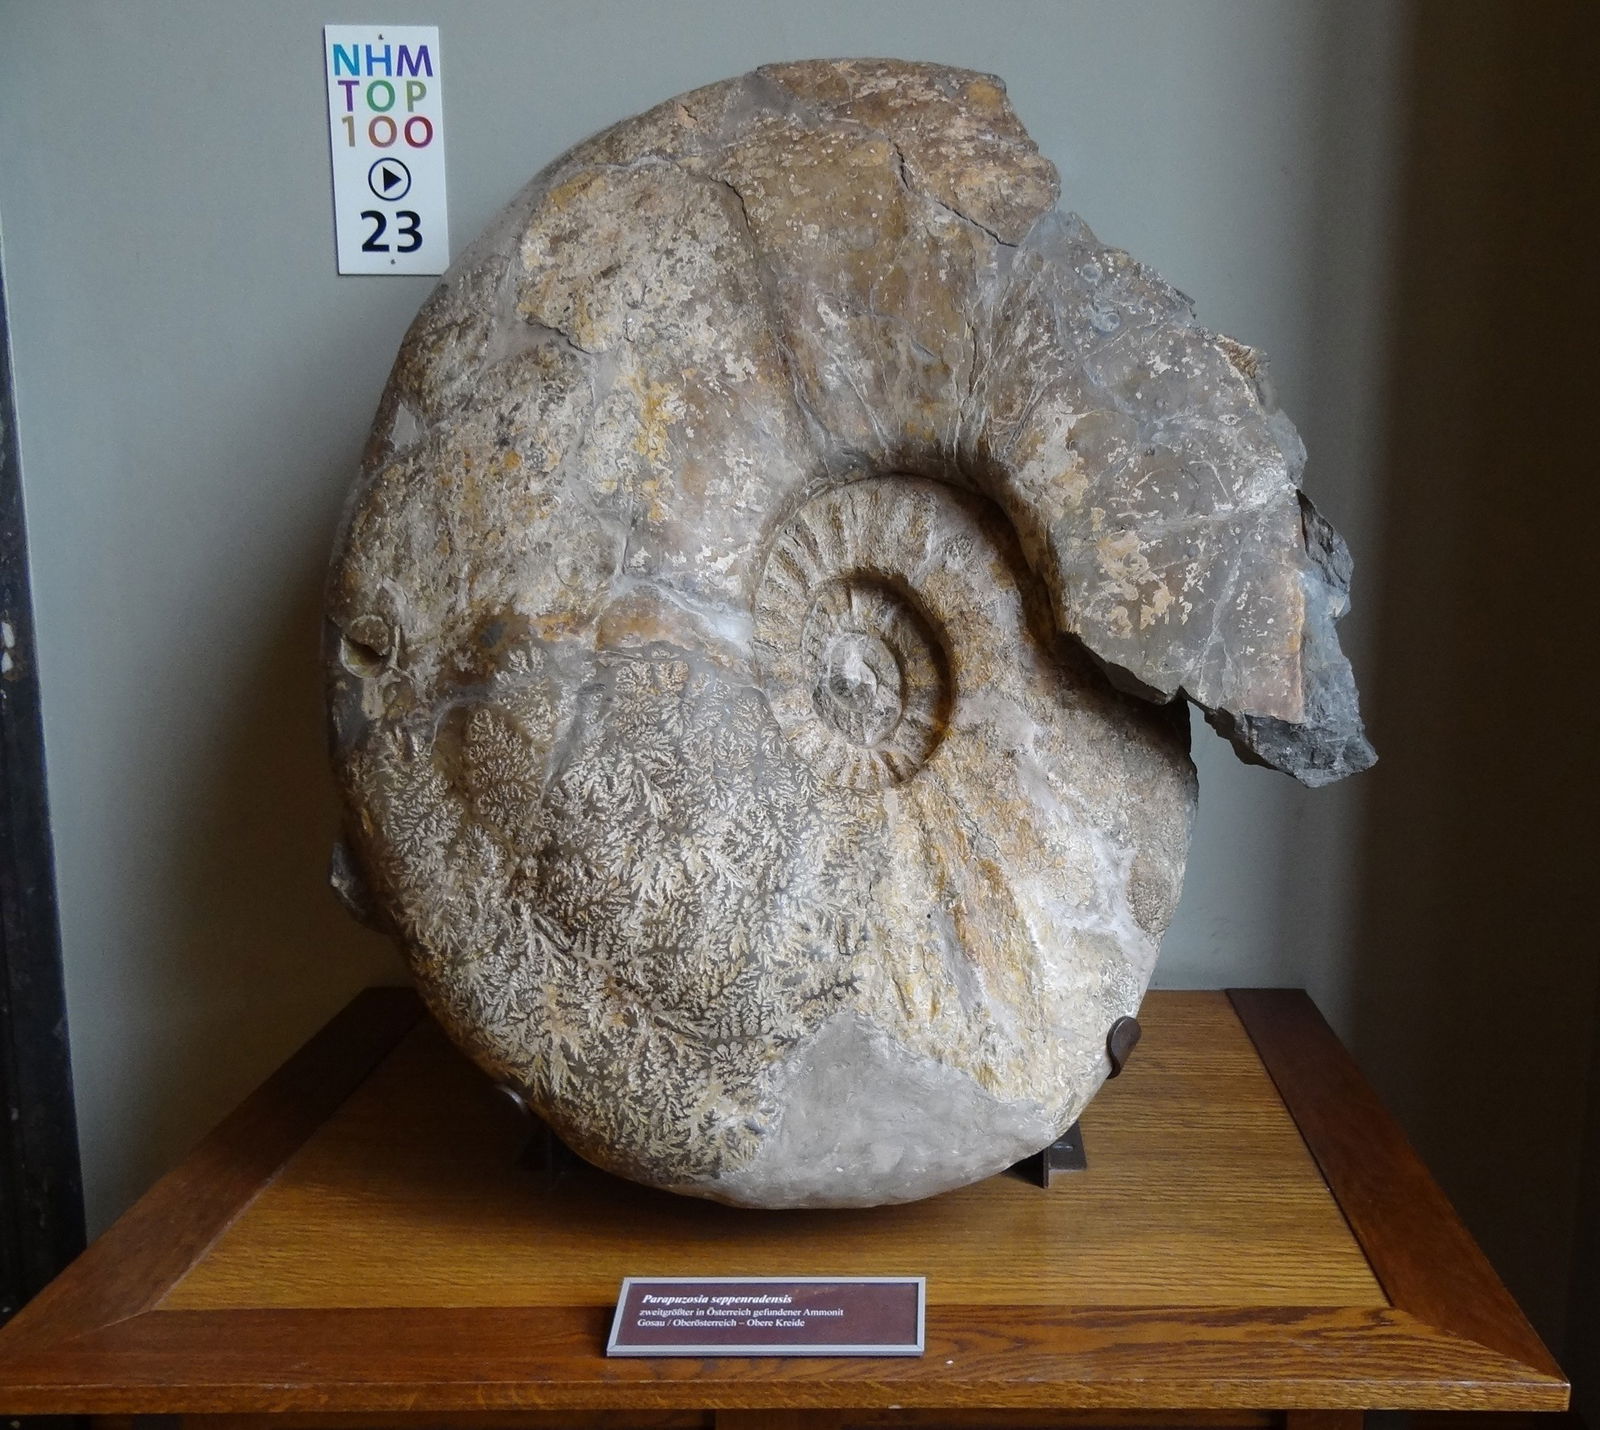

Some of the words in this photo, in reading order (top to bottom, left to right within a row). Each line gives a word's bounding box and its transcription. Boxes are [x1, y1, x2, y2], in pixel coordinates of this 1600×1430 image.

[332, 43, 434, 77] NHM
[337, 79, 428, 113] TOP
[341, 115, 434, 148] 100
[360, 209, 424, 253] 23
[639, 1308, 694, 1318] zweitgrößter
[696, 1308, 705, 1316] in
[706, 1306, 752, 1316] Österreich
[752, 1308, 802, 1318] gefundener
[803, 1308, 844, 1317] Ammonit
[642, 1294, 709, 1306] Parapuzosia
[710, 1294, 793, 1306] seppenradensis
[637, 1318, 665, 1327] Gosau
[672, 1318, 737, 1327] Oberösterreich
[746, 1318, 774, 1327] Obere
[775, 1318, 806, 1327] Kreide
